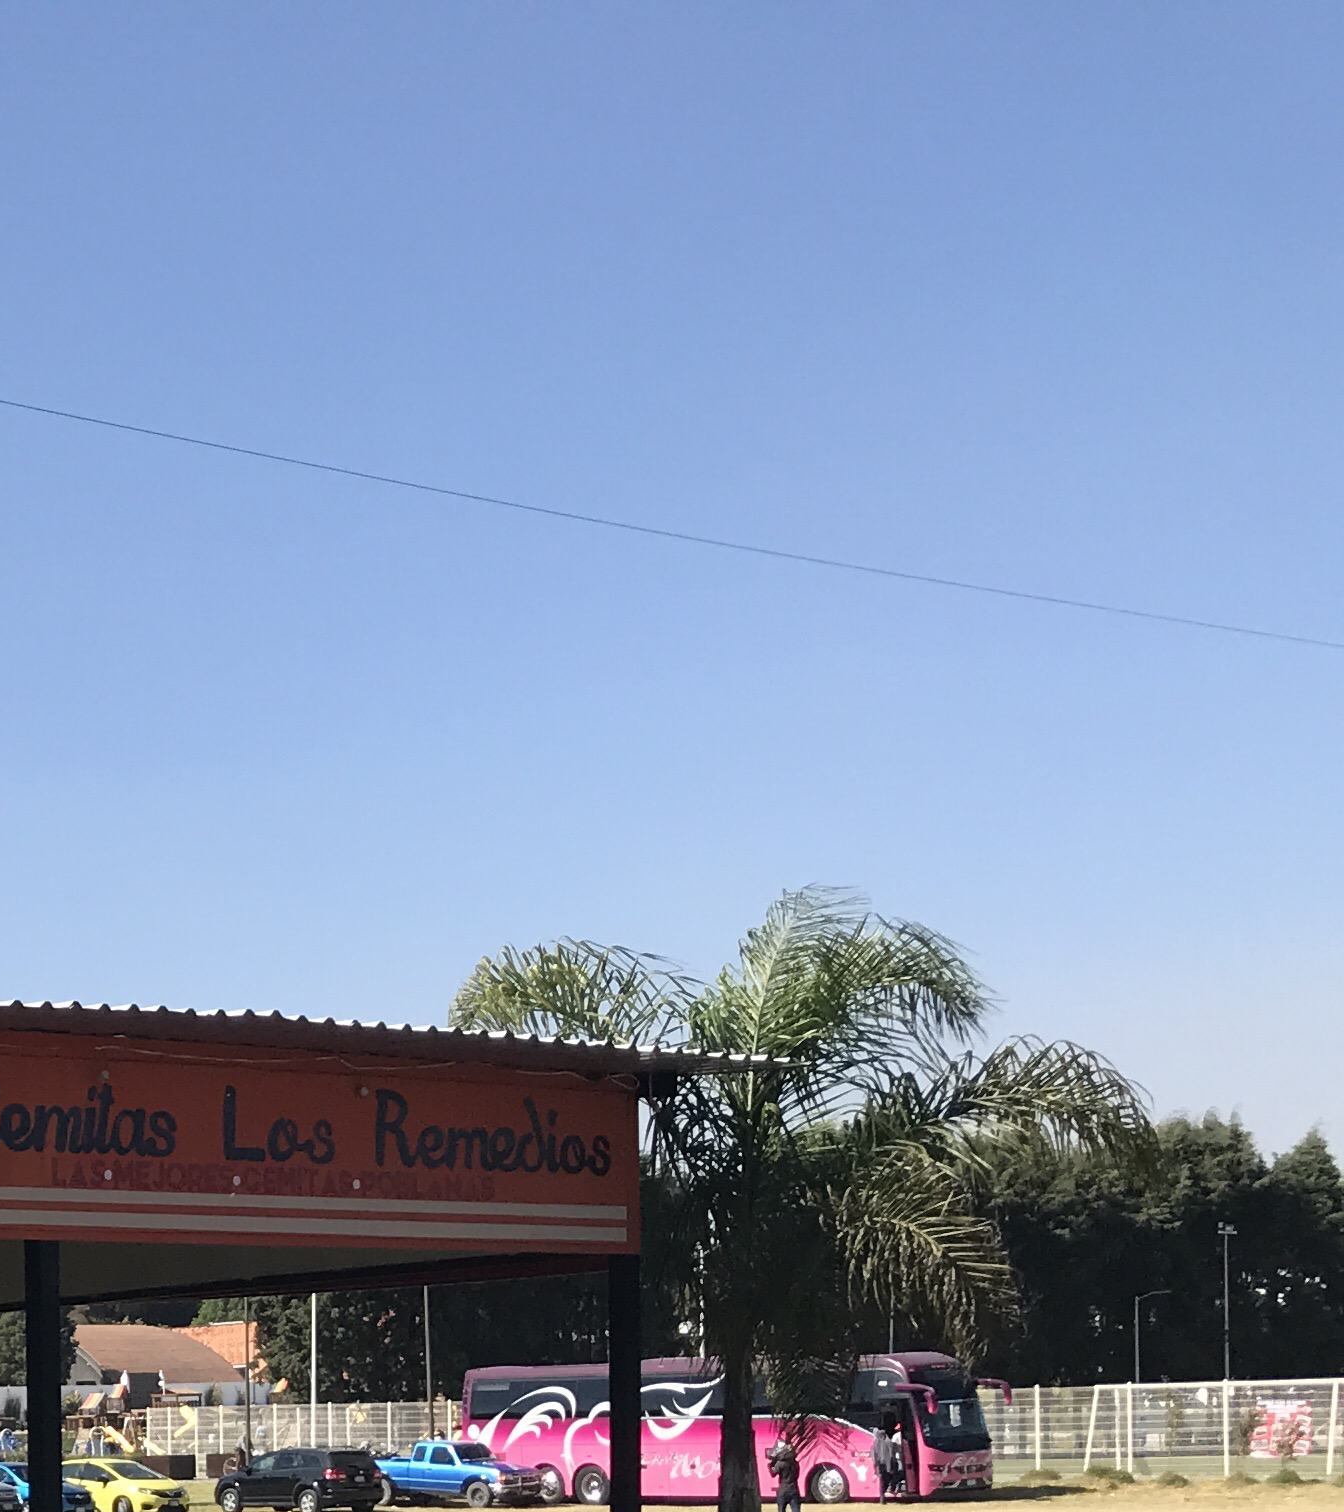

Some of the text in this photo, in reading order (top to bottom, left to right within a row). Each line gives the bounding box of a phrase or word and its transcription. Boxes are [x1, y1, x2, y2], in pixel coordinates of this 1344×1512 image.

[223, 1085, 336, 1165] Los
[374, 1088, 611, 1177] Remedios
[50, 1157, 106, 1188] LAS
